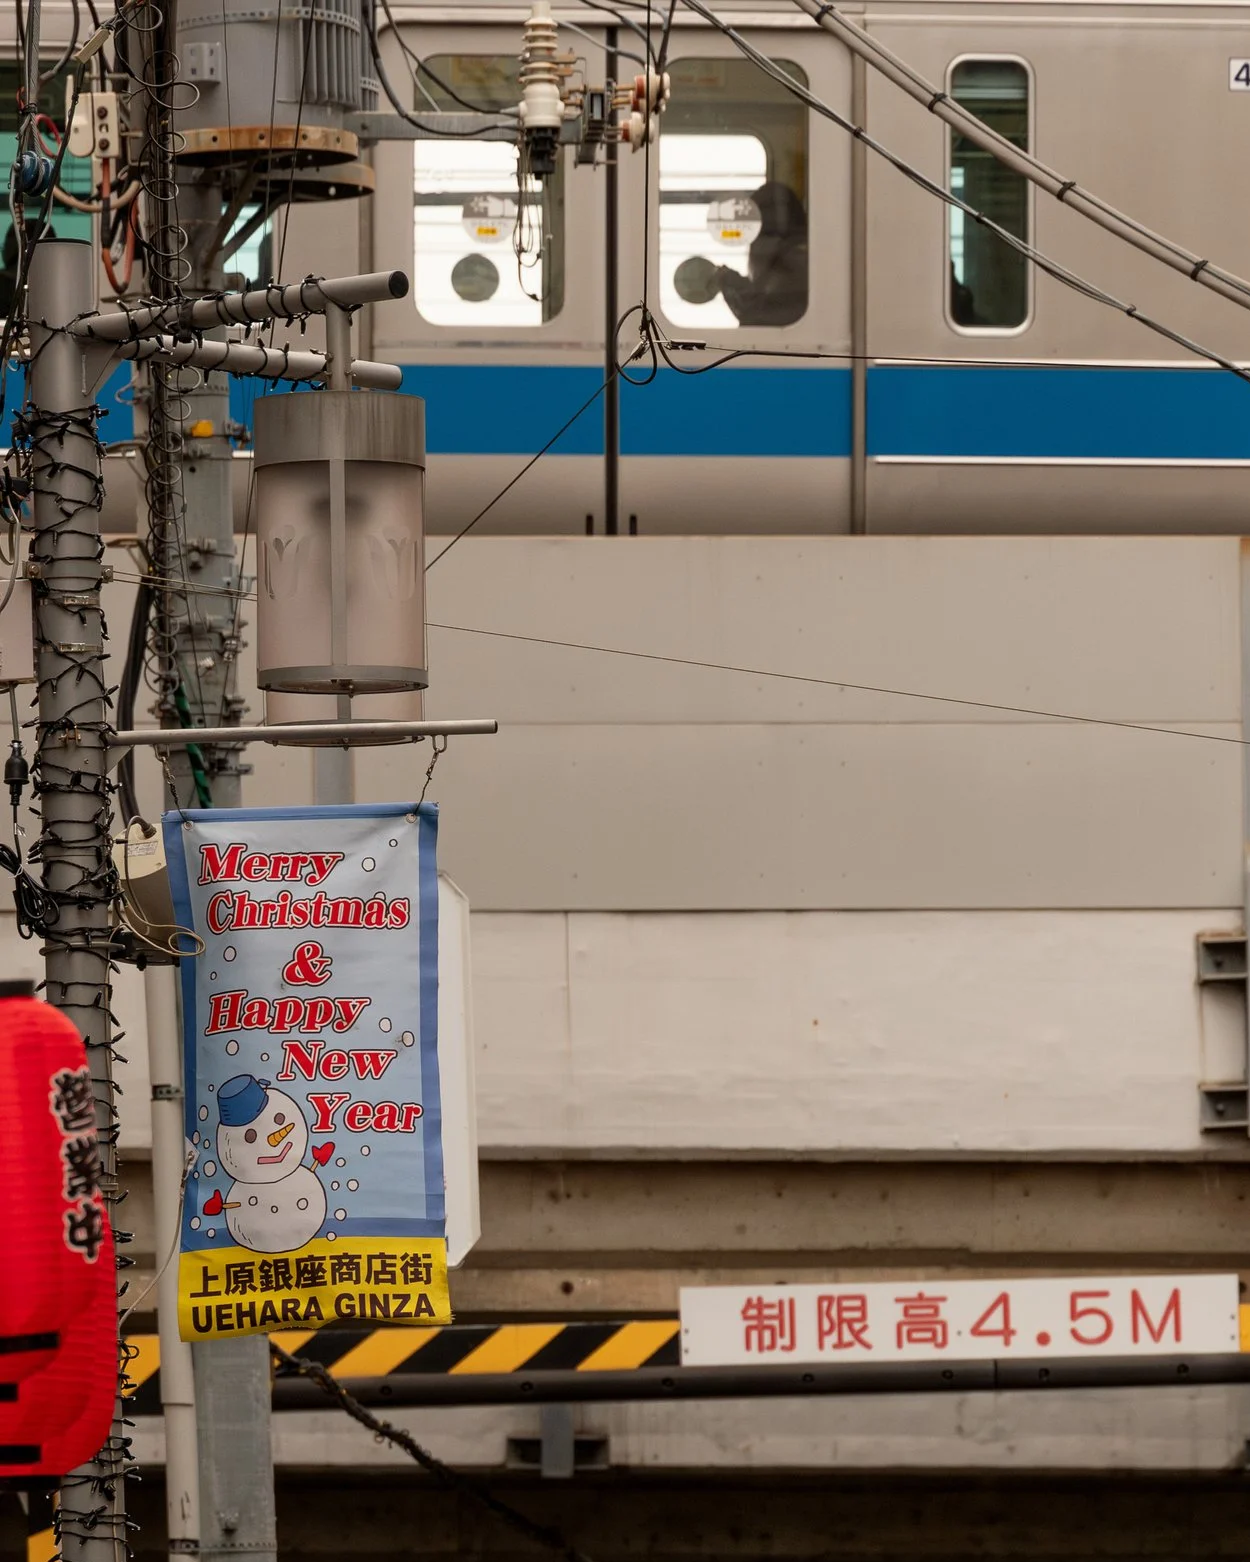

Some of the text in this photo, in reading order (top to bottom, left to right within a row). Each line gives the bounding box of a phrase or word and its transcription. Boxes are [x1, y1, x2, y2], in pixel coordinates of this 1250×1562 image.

[199, 843, 344, 886] Merry
[207, 890, 410, 934] Christmas
[282, 940, 332, 986] &
[205, 990, 371, 1035] Happy
[277, 1040, 397, 1080] New
[307, 1093, 423, 1133] Year
[189, 1252, 433, 1298] 上原銀座商店街
[192, 1293, 435, 1333] UEHARA GINZA
[740, 1288, 1183, 1353] 制限高4.5M
